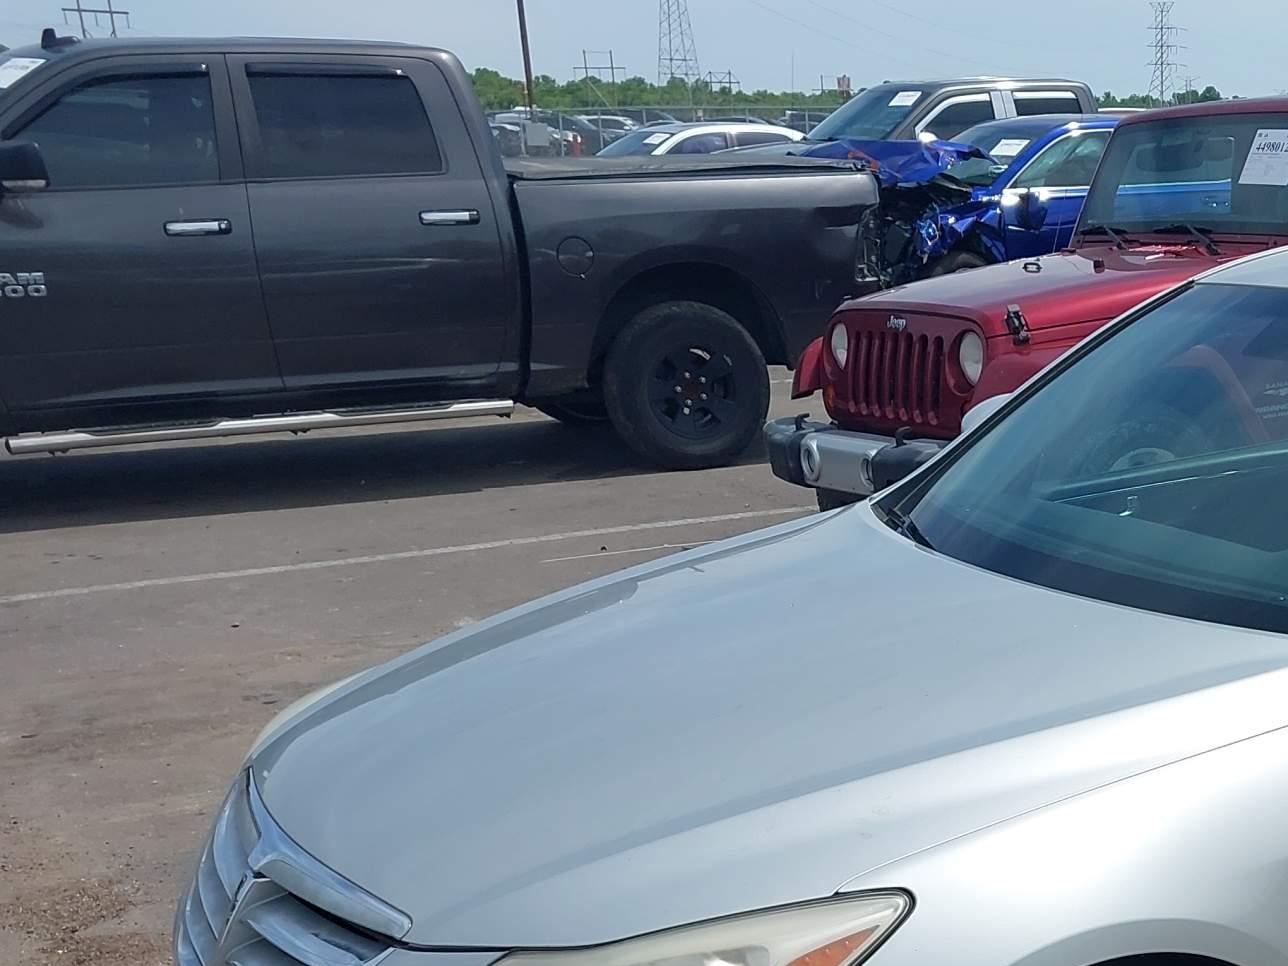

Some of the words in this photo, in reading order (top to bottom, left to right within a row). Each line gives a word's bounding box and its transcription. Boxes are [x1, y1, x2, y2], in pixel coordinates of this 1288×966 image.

[0, 272, 45, 285] AM
[0, 285, 48, 297] 00
[887, 315, 906, 331] Jeep
